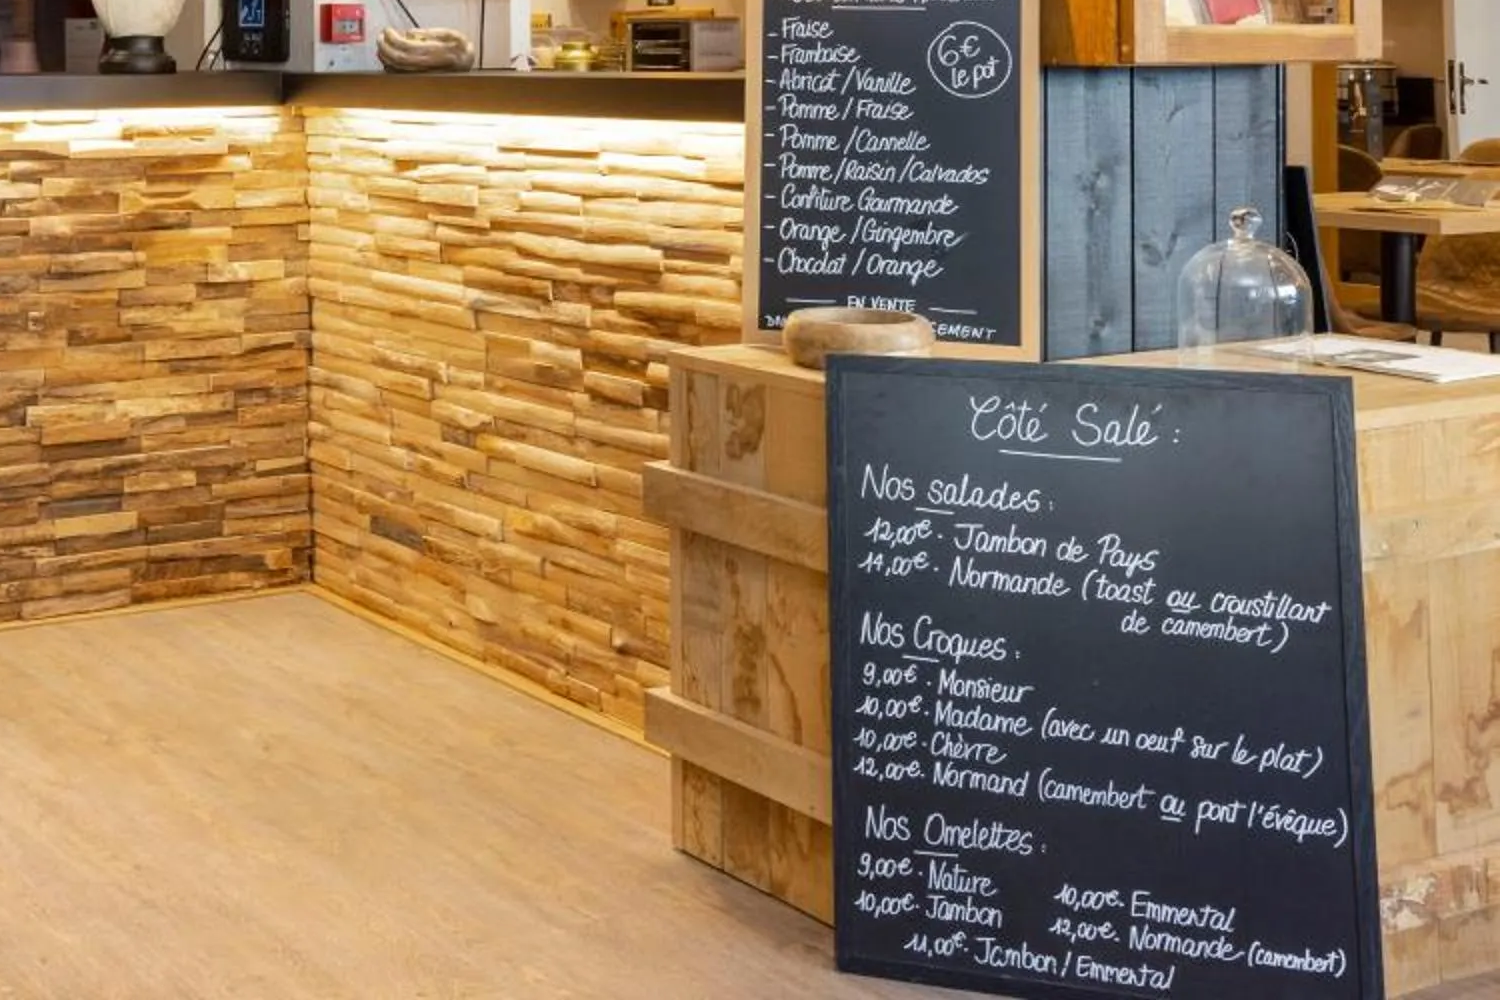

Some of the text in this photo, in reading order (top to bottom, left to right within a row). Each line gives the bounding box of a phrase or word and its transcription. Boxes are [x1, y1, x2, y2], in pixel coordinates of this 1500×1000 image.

[782, 16, 834, 39] Fraise
[781, 41, 861, 64] Framboise
[937, 34, 981, 66] 6€
[779, 67, 841, 93] Abricot
[951, 55, 1001, 89] le pot
[778, 93, 841, 120] Pomme
[856, 99, 915, 120] Fraise
[779, 123, 840, 150] Pomme
[779, 152, 833, 179] Pomme
[781, 183, 959, 215] Confiture Gourmande
[779, 217, 847, 250] Orange
[777, 247, 847, 274] Chocolat
[866, 253, 944, 286] Orange
[847, 295, 916, 312] EN VENTE
[970, 395, 1048, 442] Côté
[861, 463, 915, 501] Nos
[953, 524, 1047, 557] Jambon
[1056, 536, 1090, 563] de
[1097, 533, 1160, 578] Pays
[948, 556, 1071, 597] Normande
[1081, 569, 1156, 605] (toast
[1166, 588, 1201, 611] ou
[1210, 590, 1332, 624] croustillant
[860, 611, 905, 648] Nos
[1121, 608, 1289, 654] de camembert)
[937, 668, 1036, 703] Monsieur
[930, 731, 1008, 765] Chèvre
[934, 699, 1034, 737] Madame
[1041, 707, 1095, 741] (avec
[1100, 727, 1130, 747] un
[1135, 727, 1186, 754] oeuf
[1190, 735, 1229, 760] sur
[1231, 733, 1259, 765] le
[1258, 743, 1324, 779] plat)
[933, 761, 1029, 798] Normand
[1038, 767, 1156, 810] (camembert
[1159, 794, 1186, 817] ou
[1195, 799, 1247, 835] pont
[865, 804, 912, 841] Nos
[928, 859, 998, 897] Nature
[925, 894, 1003, 929] Jambon
[1130, 890, 1236, 932] Emmental
[973, 937, 1058, 974] Jambon
[1075, 955, 1176, 990] Emmental
[1128, 925, 1245, 961] Normande
[1247, 941, 1347, 978] (camembert)
